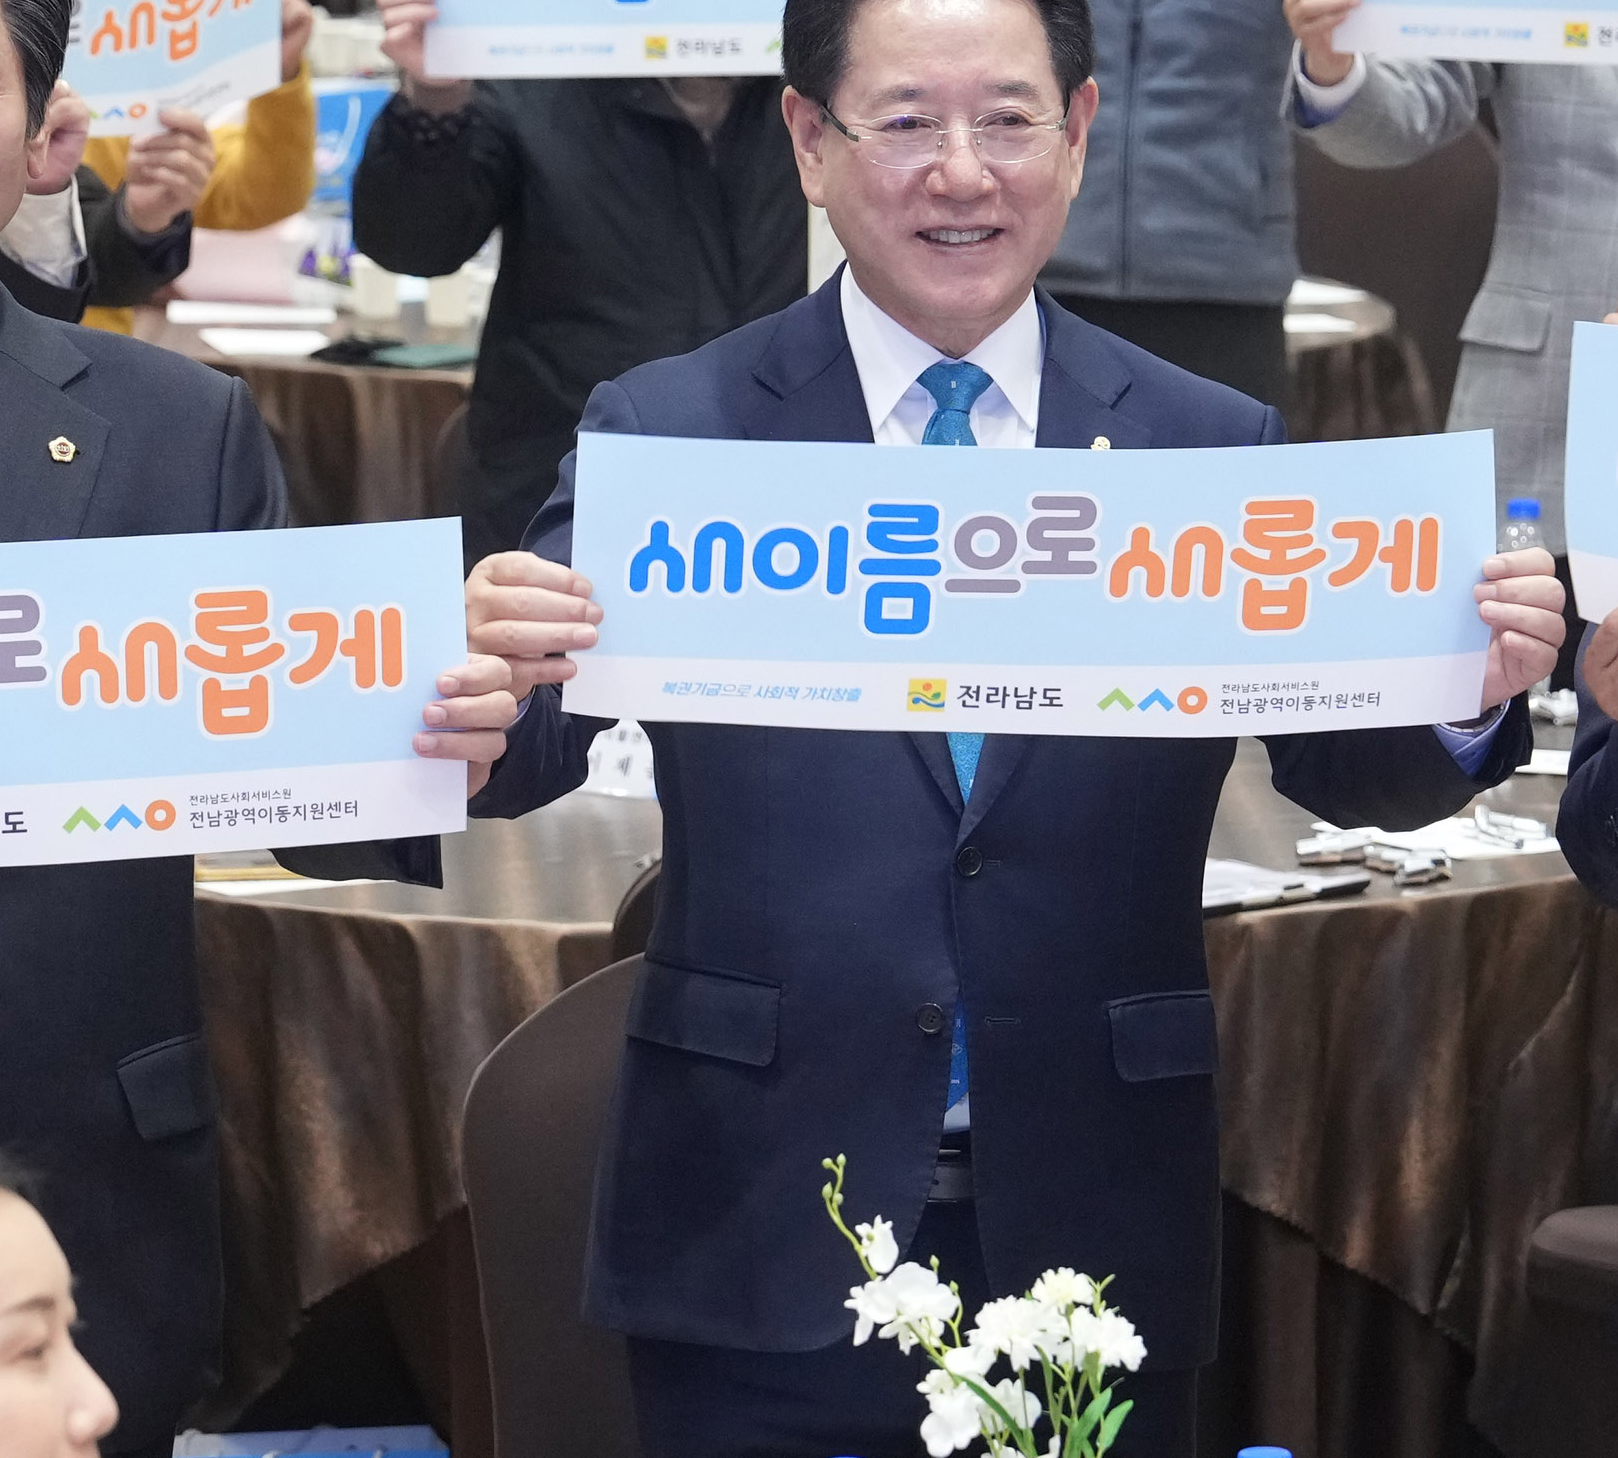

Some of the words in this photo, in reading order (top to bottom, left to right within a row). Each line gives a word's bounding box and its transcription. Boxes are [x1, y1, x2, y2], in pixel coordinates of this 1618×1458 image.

[629, 494, 1100, 635] 새이름으로
[1109, 498, 1440, 631] 새롭게
[61, 589, 404, 735] 새롭게
[662, 680, 752, 699] 복권기금으로
[753, 684, 801, 700] 사회적
[803, 685, 863, 704] 가치창출
[956, 684, 1065, 711] 전라남도
[1220, 680, 1321, 695] 전라남도사회서비스원
[1219, 690, 1382, 716] 전남광역이동지원센터
[188, 787, 293, 807] 전라남도사회서비스원
[188, 799, 360, 830] 전남광역이동지원센터
